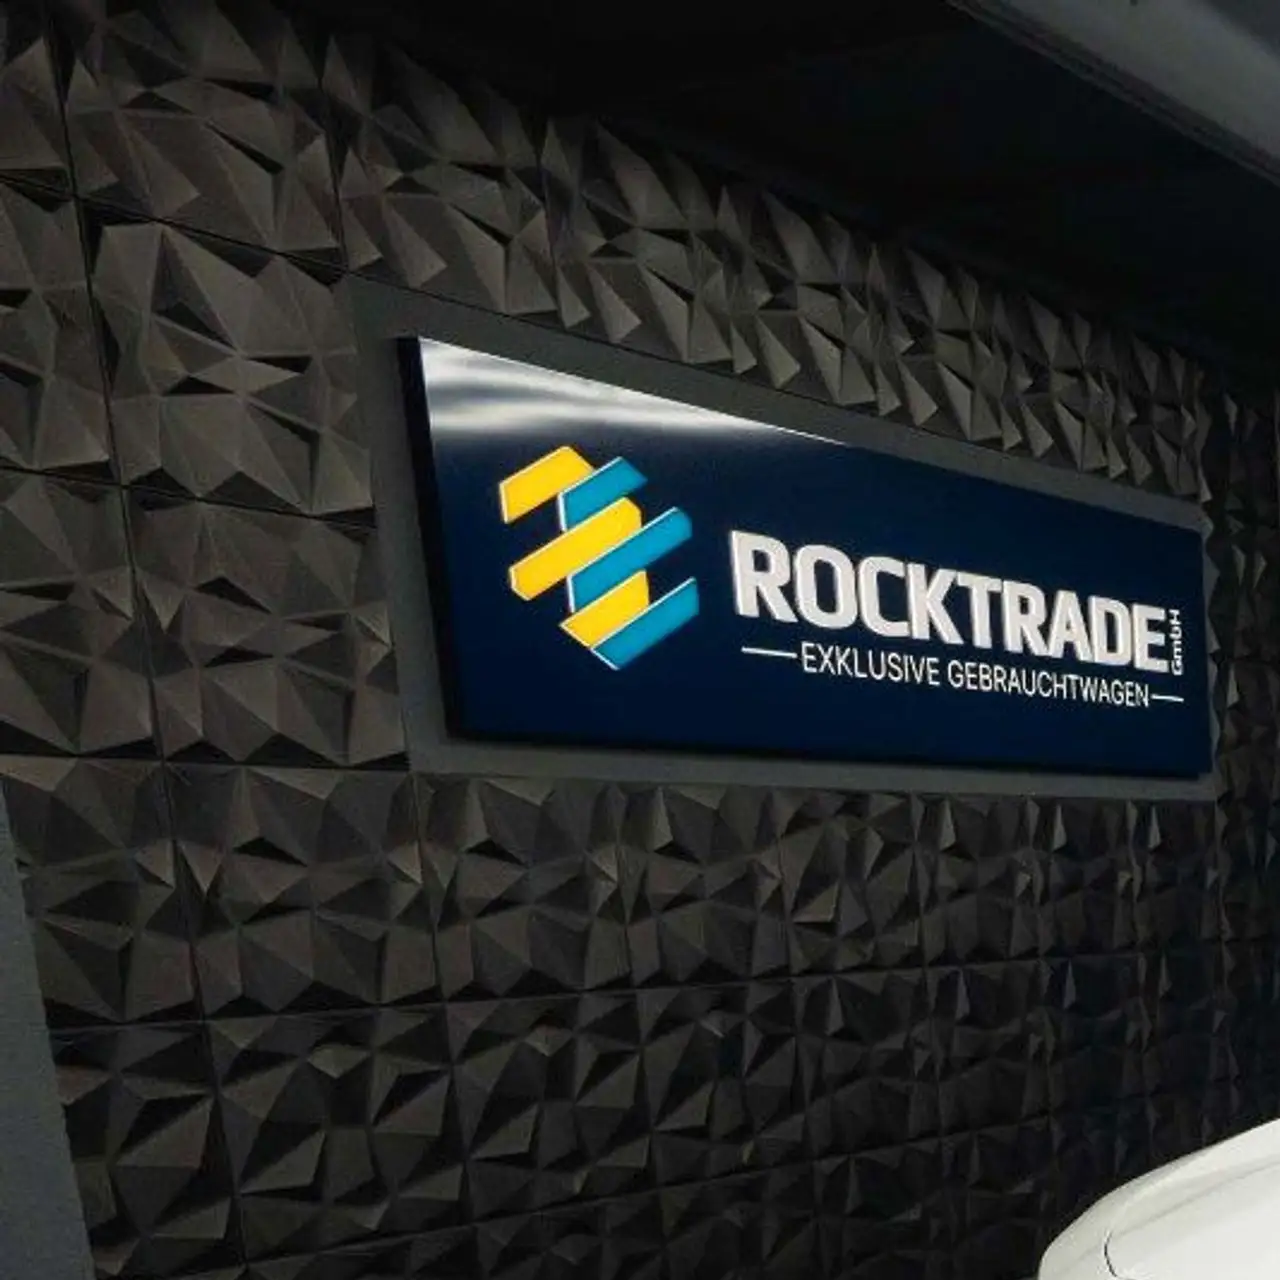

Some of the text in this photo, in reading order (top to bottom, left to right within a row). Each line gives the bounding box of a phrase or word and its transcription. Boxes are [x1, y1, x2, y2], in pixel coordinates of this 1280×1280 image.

[730, 530, 1170, 674] ROCKTRADE
[801, 641, 1149, 708] EXKLUSIVE GEBRAUCHTWAGEN
[1168, 609, 1184, 676] GmbH
